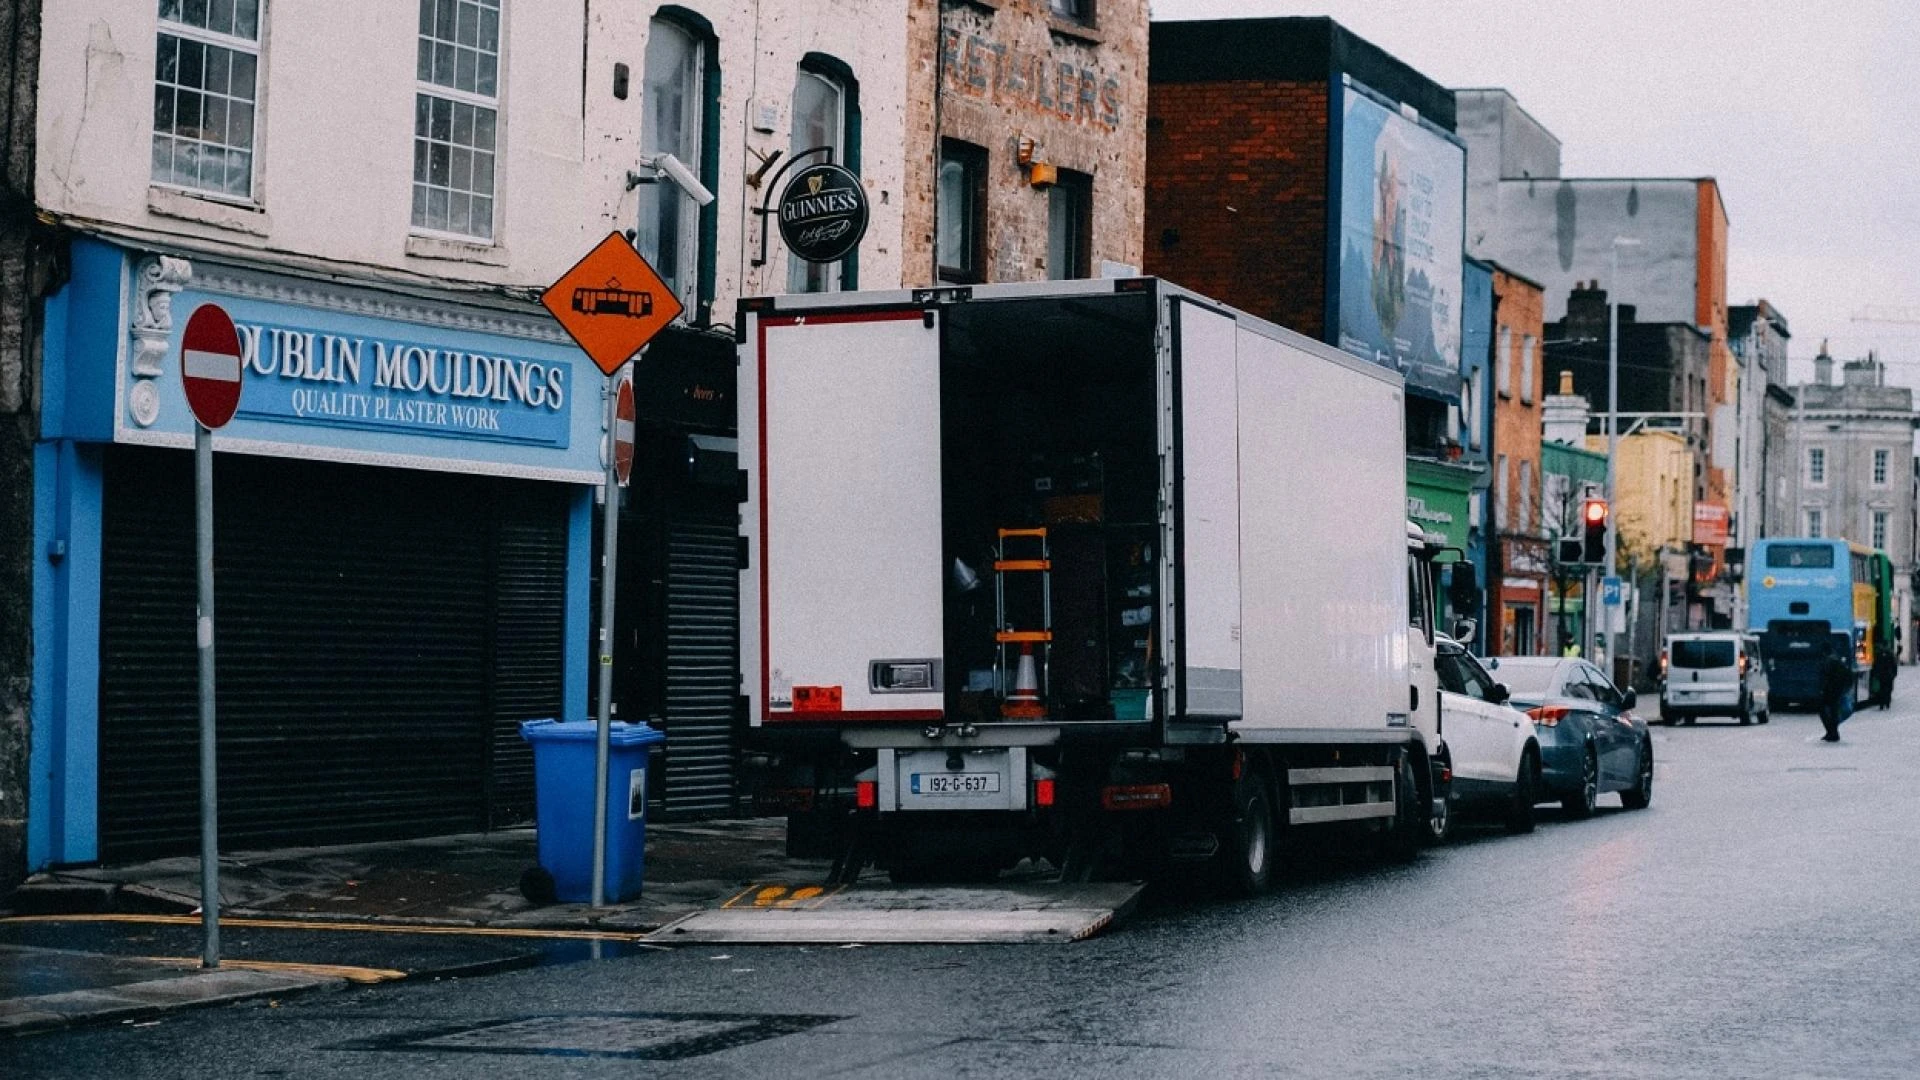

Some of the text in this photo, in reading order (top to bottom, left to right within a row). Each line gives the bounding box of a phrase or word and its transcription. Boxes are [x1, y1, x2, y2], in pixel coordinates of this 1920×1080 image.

[782, 192, 858, 222] GUINNESS
[373, 341, 564, 410] MOULDINGS
[292, 387, 500, 430] QUALITY PLASTER WORK
[930, 776, 987, 791] 192-G-637
